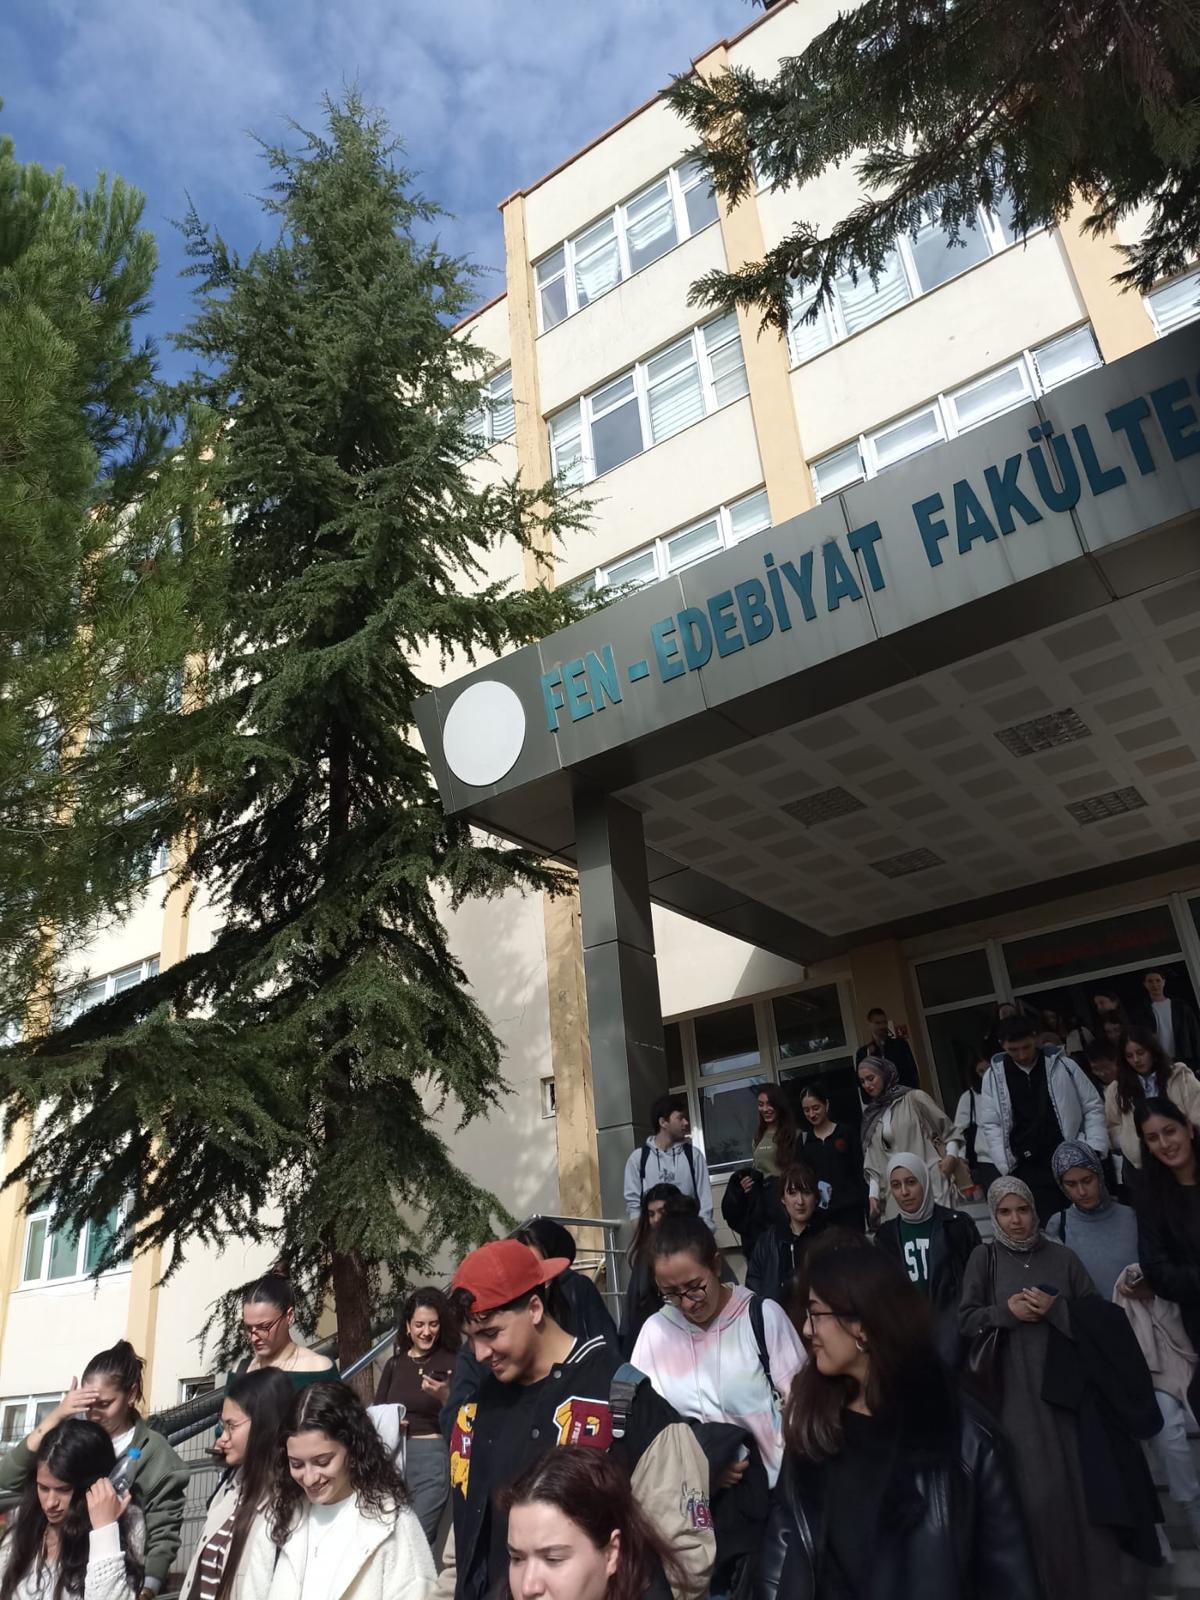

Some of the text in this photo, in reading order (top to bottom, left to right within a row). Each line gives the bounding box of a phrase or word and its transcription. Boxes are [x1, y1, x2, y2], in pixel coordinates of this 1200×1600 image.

[540, 642, 623, 734] FEN
[652, 520, 886, 684] EDEBİYAT
[911, 366, 1200, 568] FAKÜLTE
